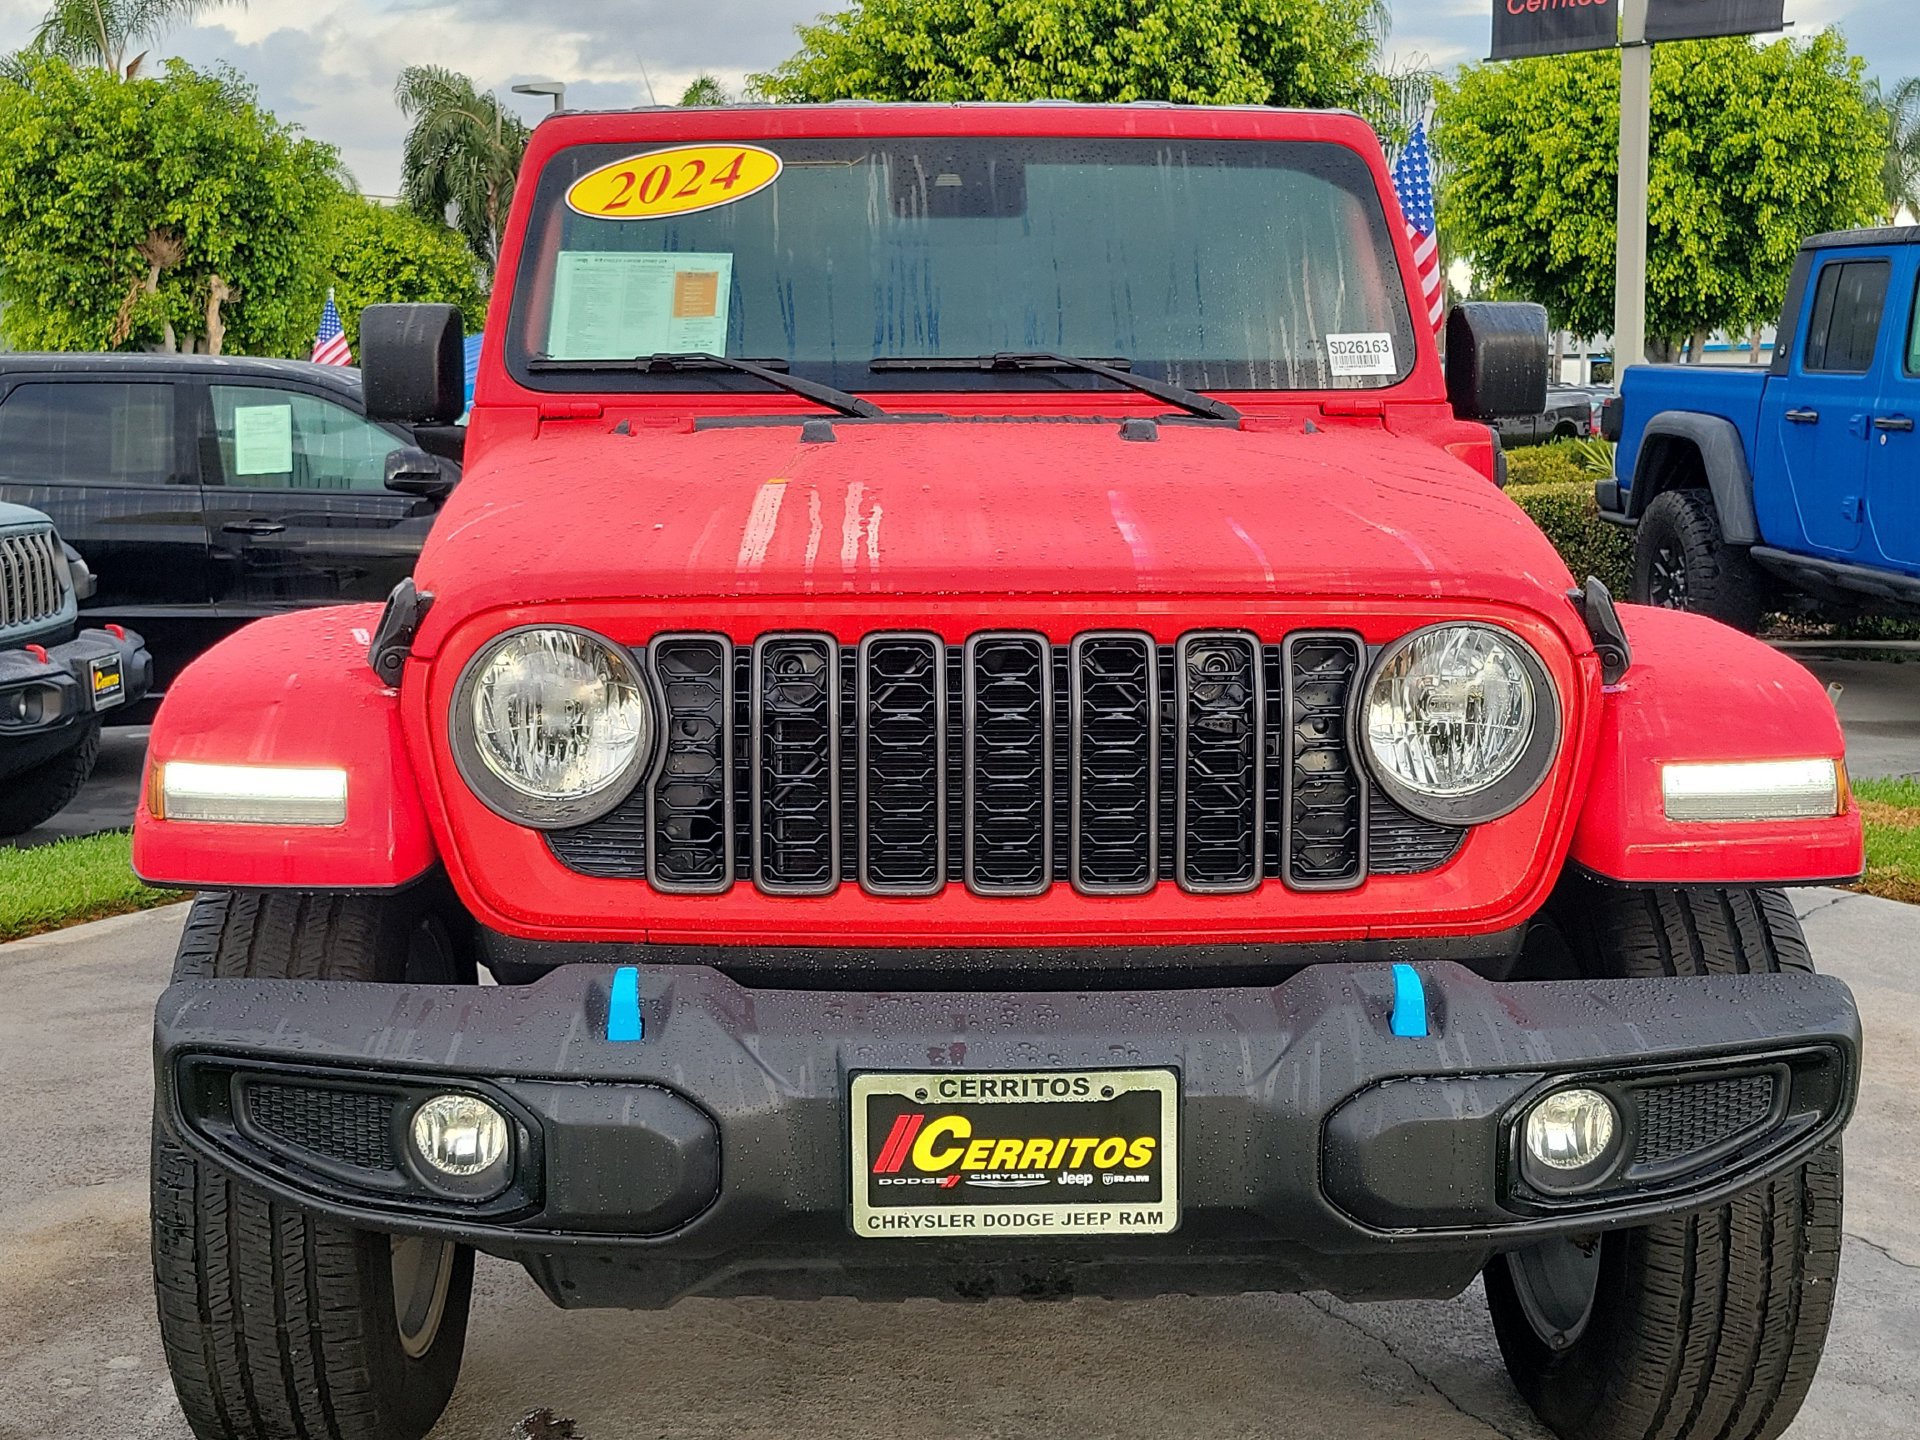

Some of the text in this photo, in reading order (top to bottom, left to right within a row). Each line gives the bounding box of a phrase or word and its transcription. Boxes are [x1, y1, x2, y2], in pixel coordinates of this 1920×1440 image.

[1507, 0, 1607, 14] Cerr
[601, 152, 746, 211] 2024
[1330, 340, 1389, 354] SD26163
[939, 1078, 1090, 1098] CERRITOS
[912, 1115, 1156, 1171] CERRITOS
[878, 1177, 948, 1186] DODGE
[970, 1173, 1045, 1181] CHRYSLER
[1058, 1171, 1093, 1187] Jeep
[1113, 1174, 1150, 1183] RAM
[867, 1210, 1164, 1229] CHRYSLER DODGE JEEP RAM
